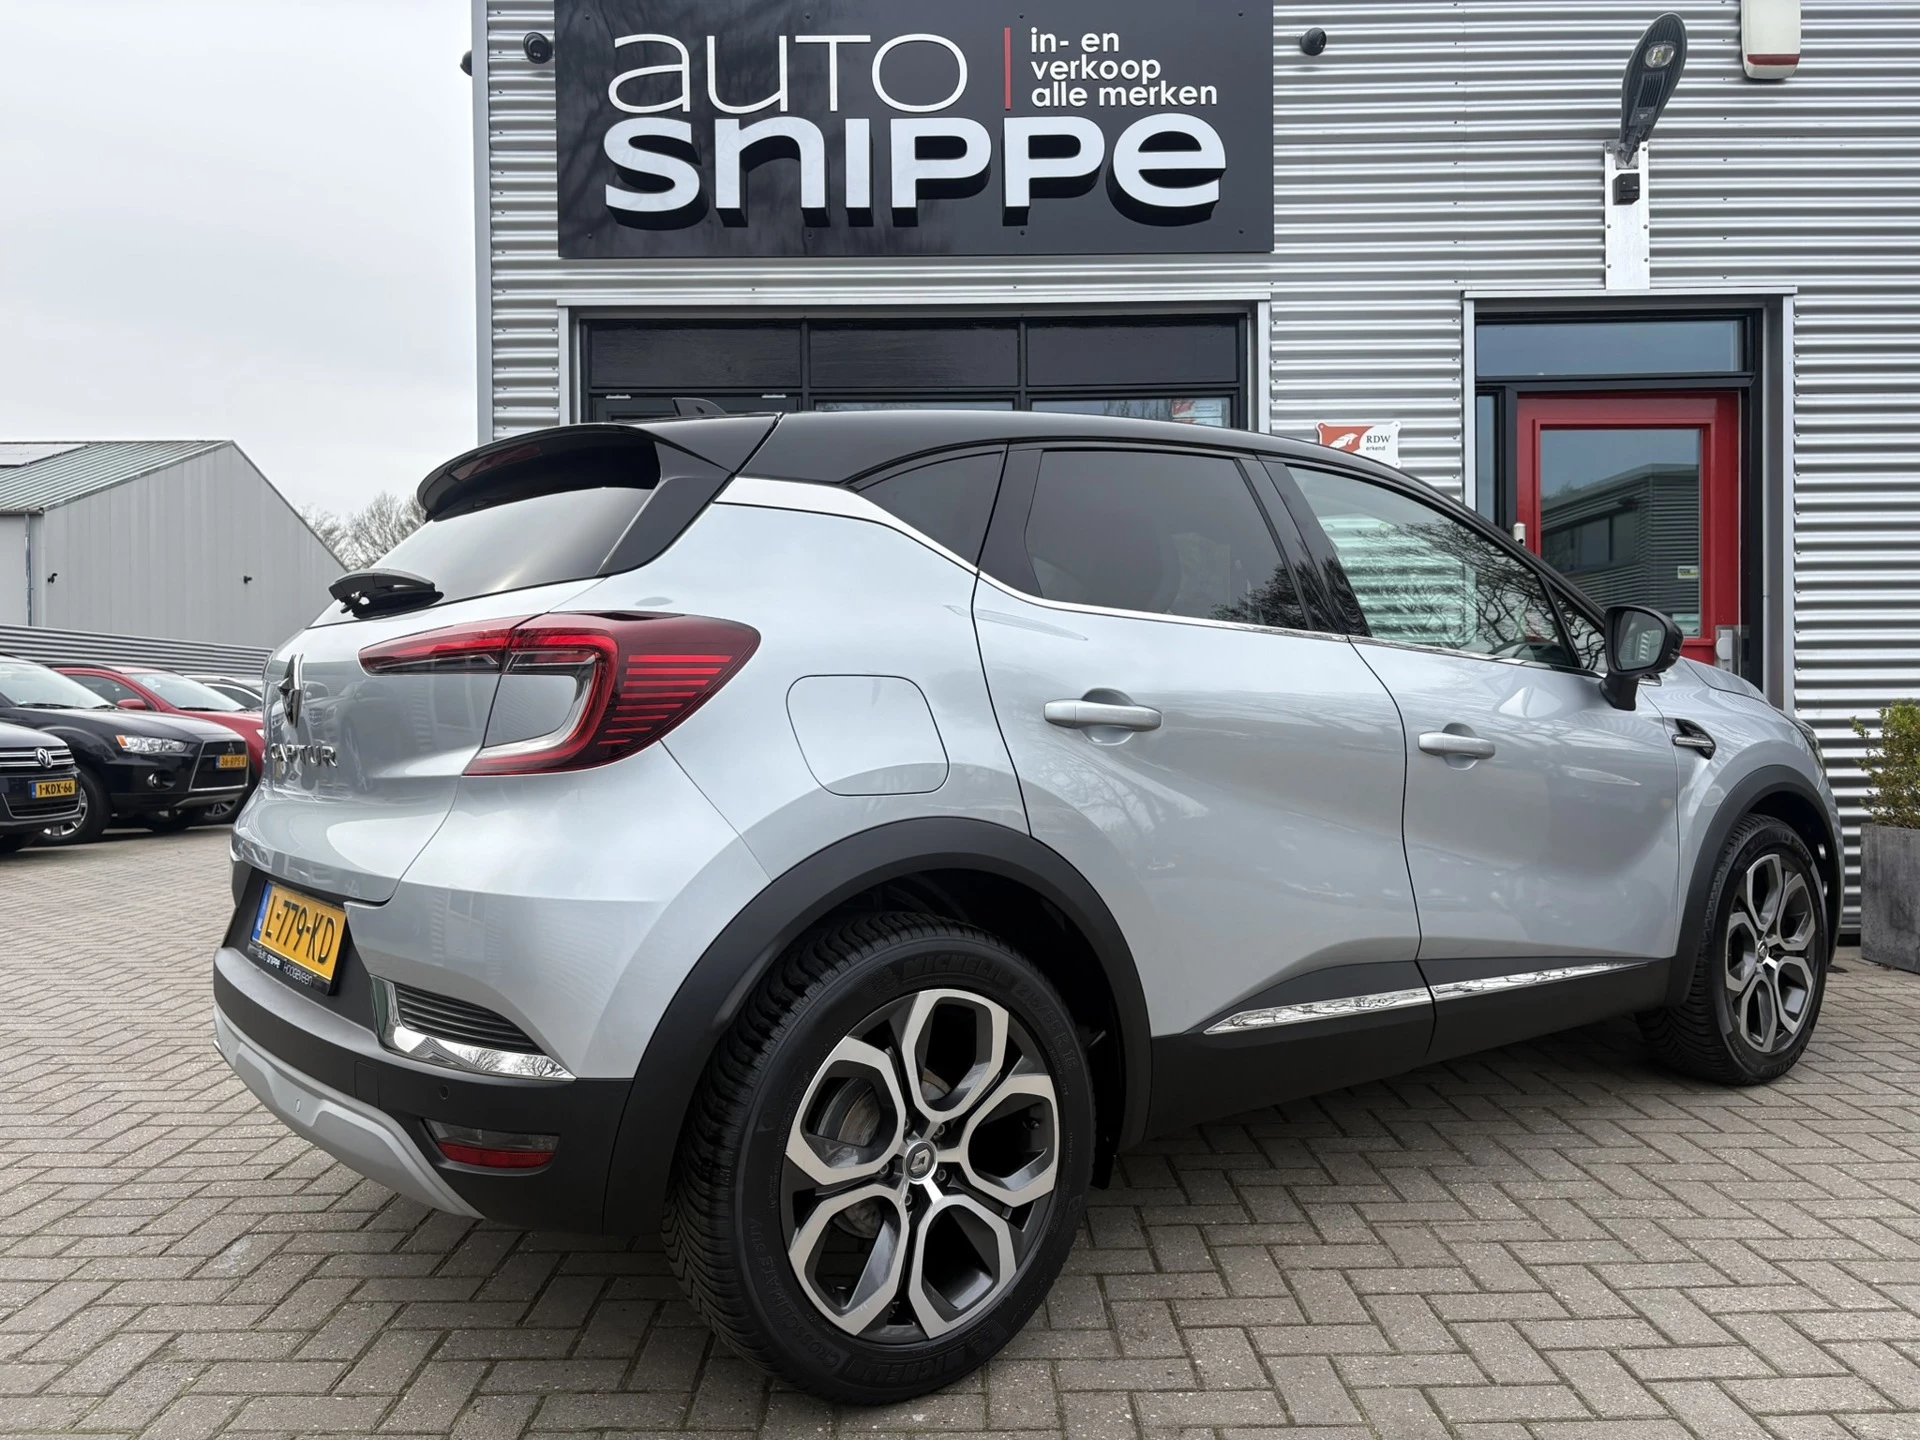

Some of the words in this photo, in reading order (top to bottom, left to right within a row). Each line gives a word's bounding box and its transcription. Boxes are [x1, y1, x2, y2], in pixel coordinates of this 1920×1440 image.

[1030, 26, 1070, 53] in-
[1081, 32, 1120, 53] en
[1030, 54, 1162, 85] verkoop
[1031, 80, 1088, 107] alle
[1098, 80, 1218, 107] merken
[1366, 434, 1391, 444] RDW
[270, 742, 338, 768] CAPTUR
[37, 781, 74, 796] 1-KDX-66
[265, 894, 337, 966] L-779-KD
